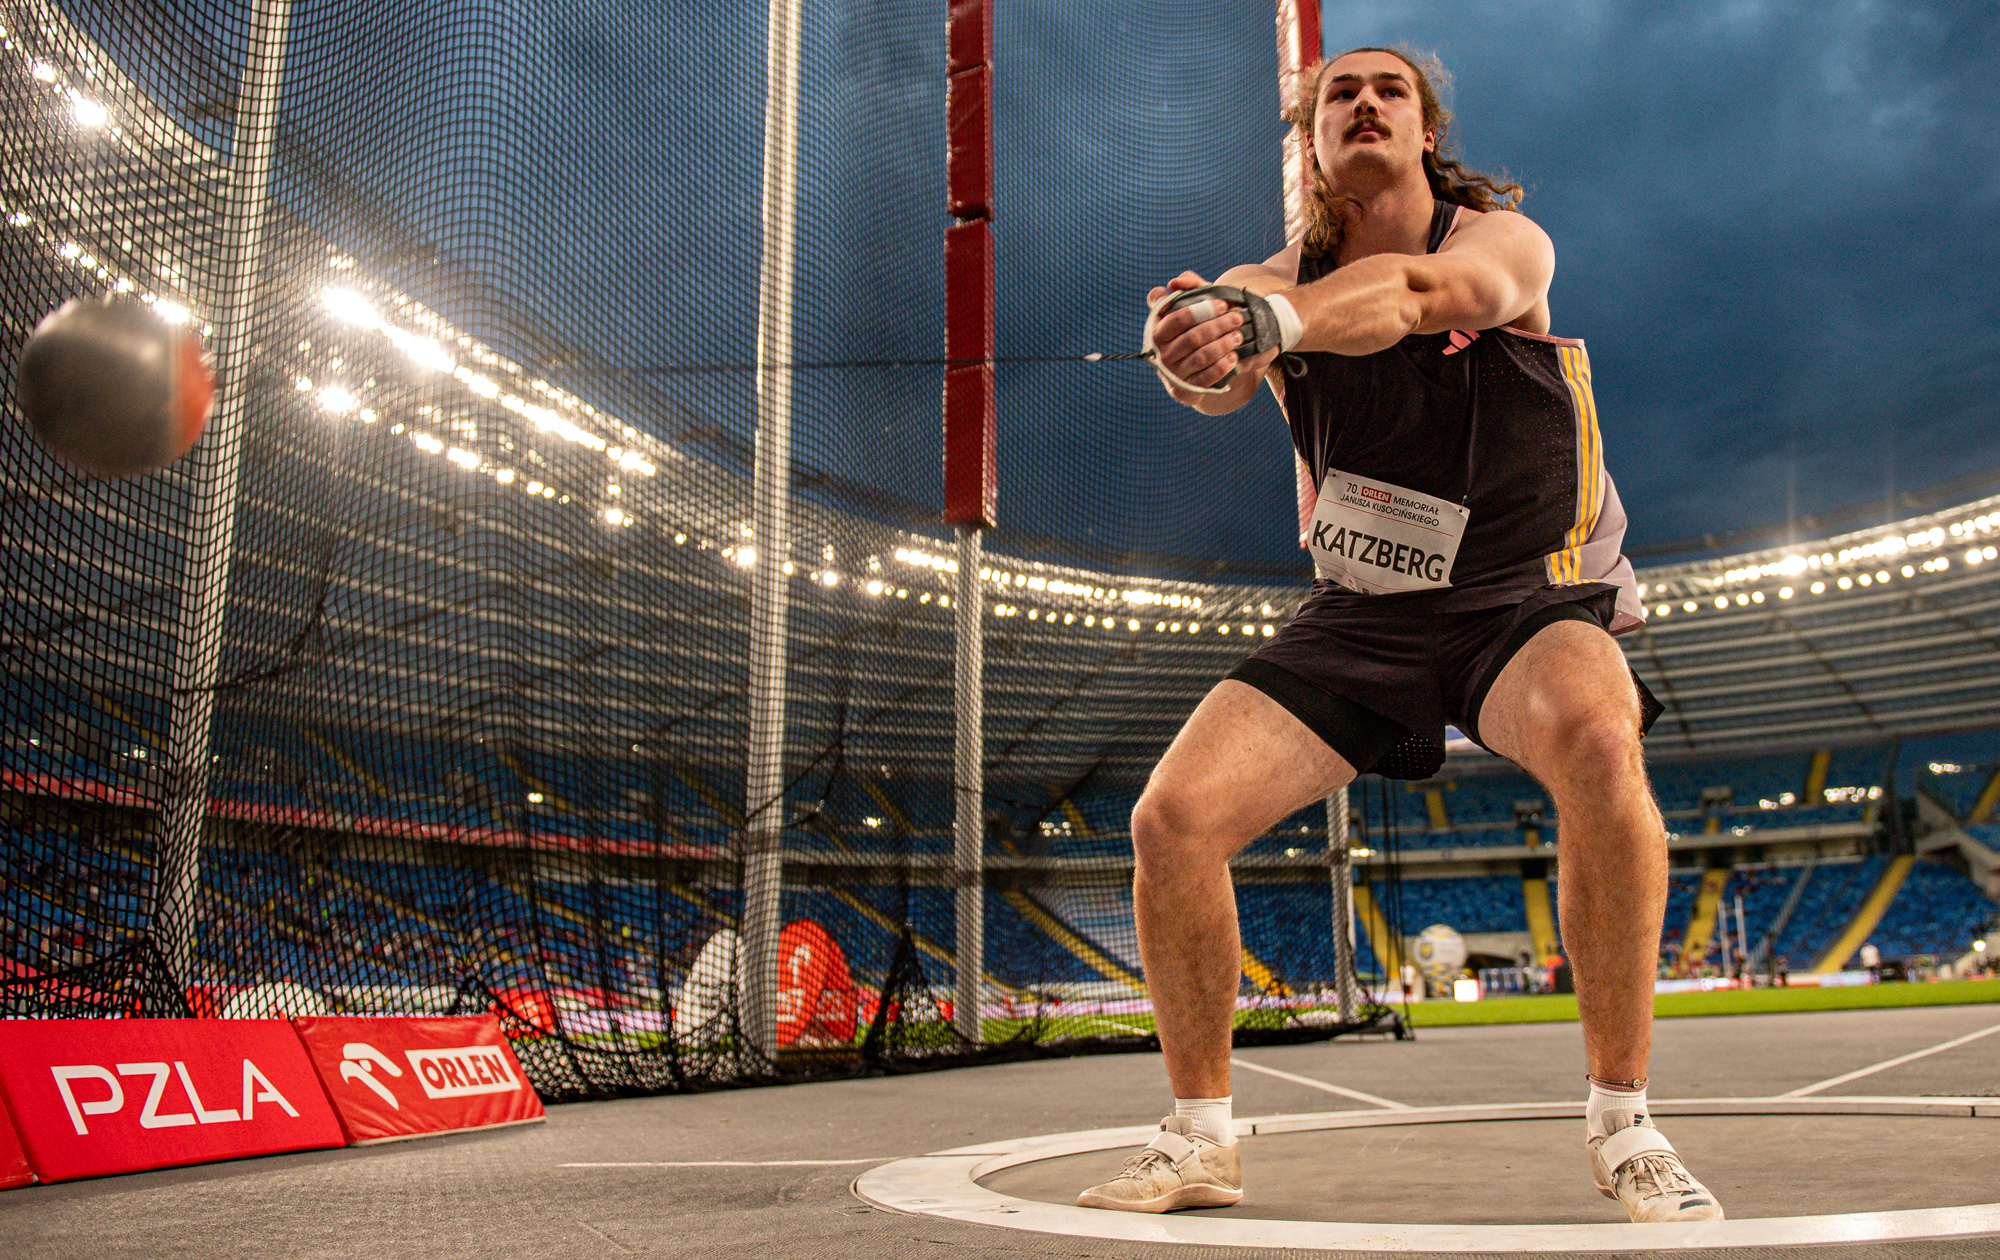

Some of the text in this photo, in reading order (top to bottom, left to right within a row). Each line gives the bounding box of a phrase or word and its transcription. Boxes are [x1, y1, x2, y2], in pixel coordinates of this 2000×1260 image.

[1340, 493, 1440, 527] JANUSZA KUSOCIŃSKIEGO
[1346, 482, 1440, 515] 70. ORLEN MEMORIAŁ
[1312, 520, 1446, 582] KATZBERG
[419, 1053, 512, 1089] ORLEN
[50, 1058, 301, 1135] PZLA
